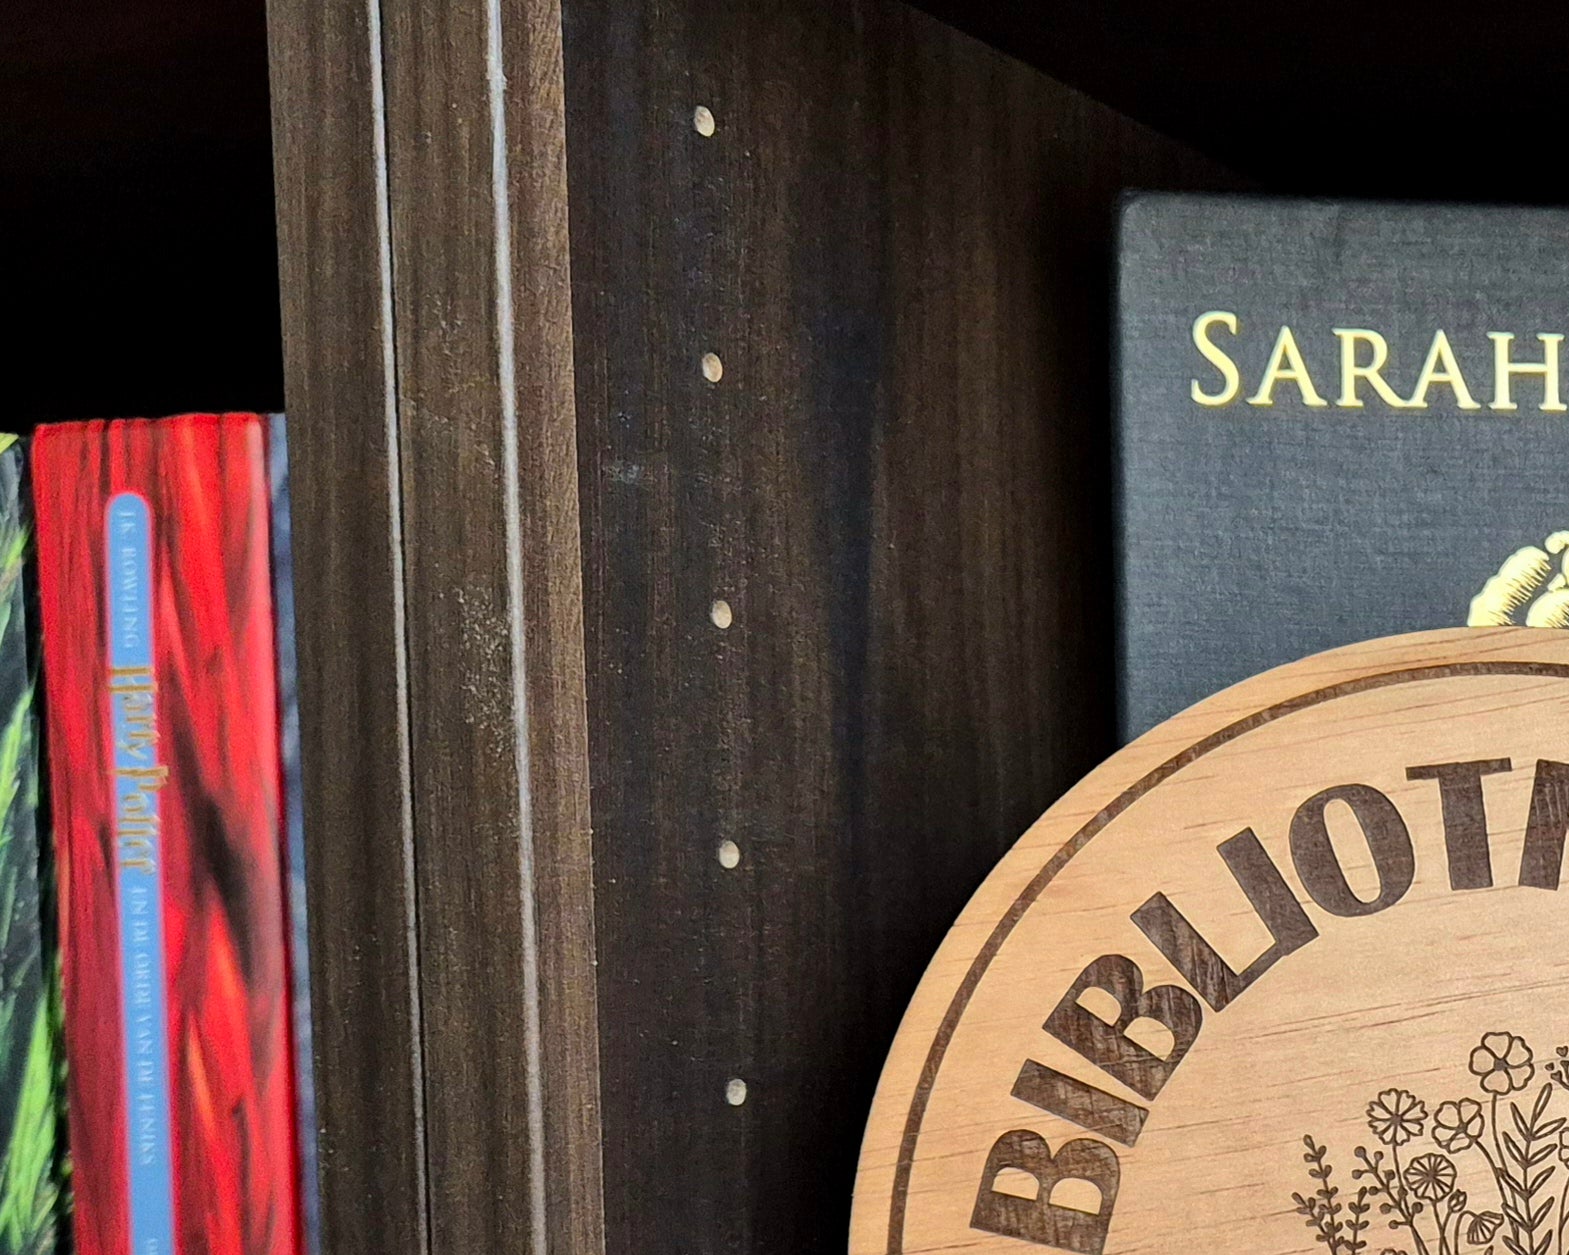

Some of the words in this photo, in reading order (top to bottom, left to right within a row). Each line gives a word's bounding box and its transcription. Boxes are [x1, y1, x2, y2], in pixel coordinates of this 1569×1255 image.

[1190, 311, 1568, 411] SARAH
[119, 546, 141, 649] ROWLING
[107, 667, 159, 760] Harry
[107, 765, 169, 874] Potter
[135, 1015, 153, 1054] VAN
[138, 1094, 157, 1166] FENIKS
